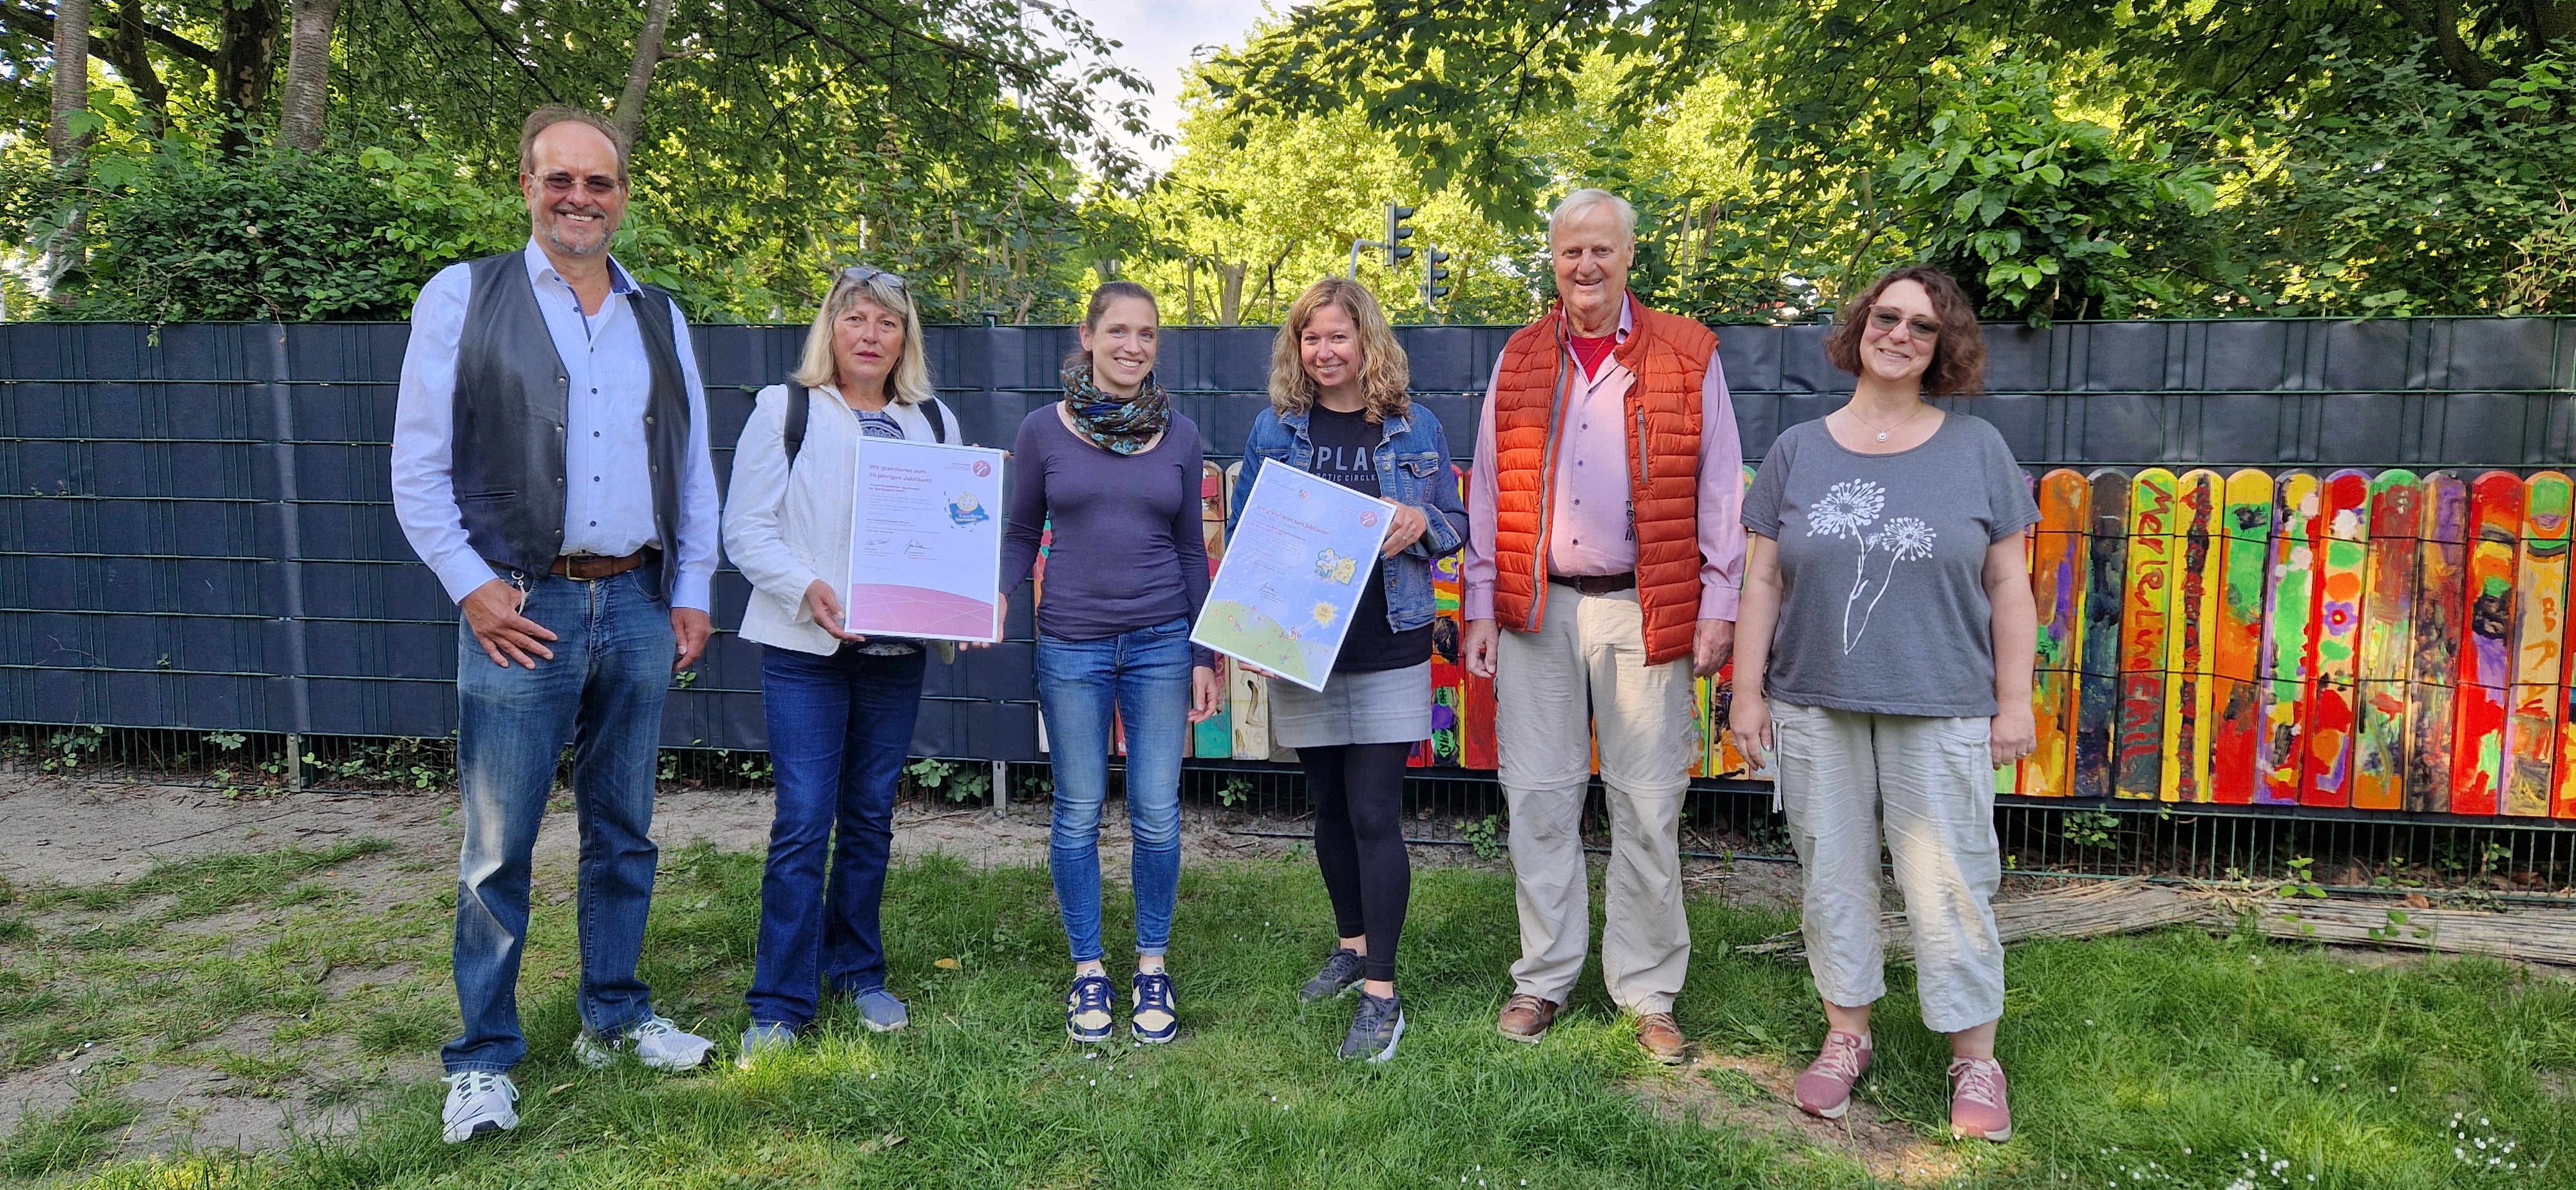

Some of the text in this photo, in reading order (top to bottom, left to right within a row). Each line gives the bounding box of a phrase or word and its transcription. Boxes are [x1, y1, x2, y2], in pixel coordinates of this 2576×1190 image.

[1316, 446, 1376, 471] PLA
[1311, 473, 1341, 482] RCTIC
[1266, 509, 1293, 522] gratulieren
